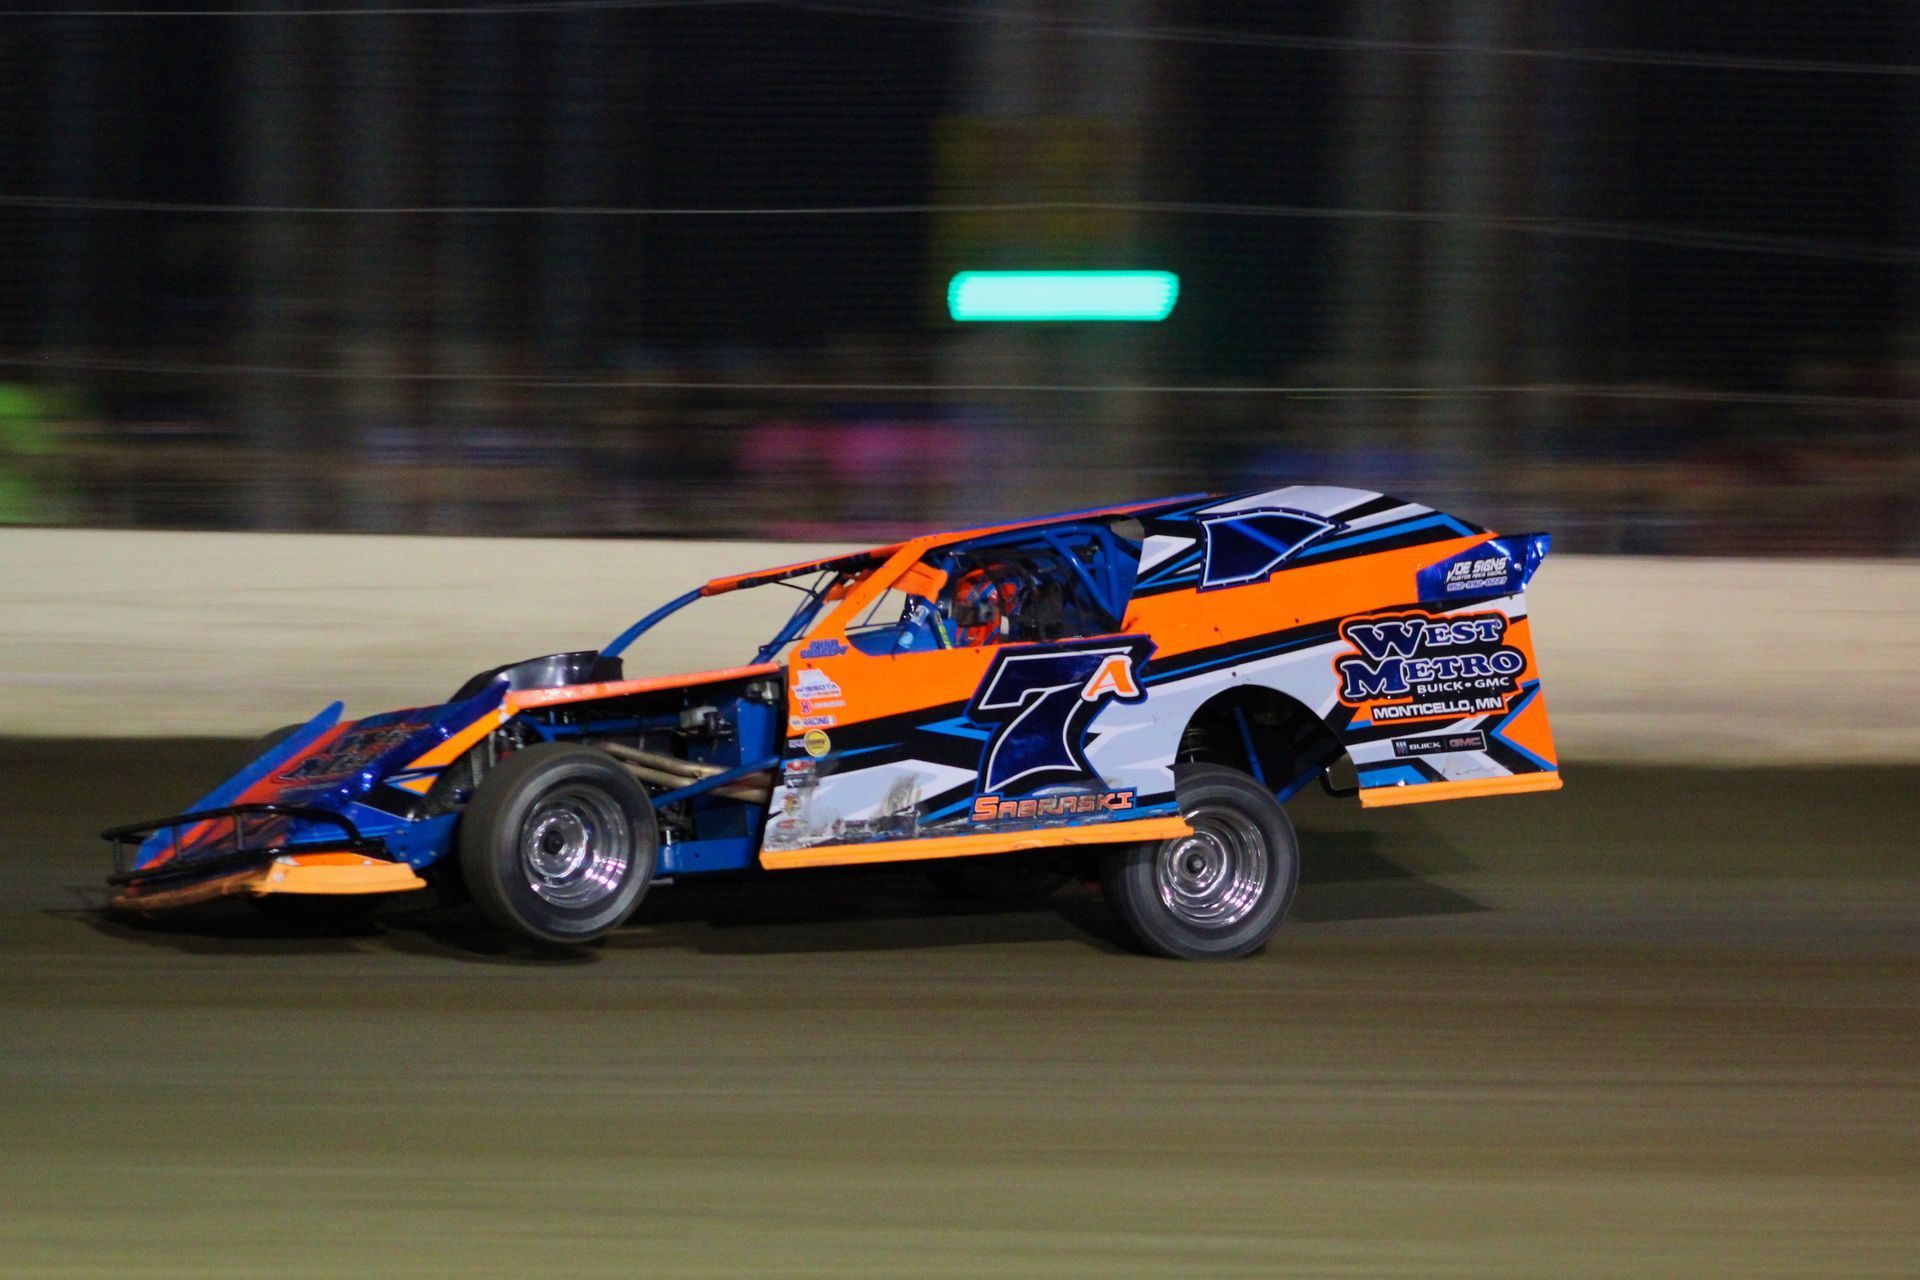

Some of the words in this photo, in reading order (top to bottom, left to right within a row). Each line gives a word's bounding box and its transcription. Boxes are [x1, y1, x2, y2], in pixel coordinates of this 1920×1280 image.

[1445, 561, 1472, 583] JOE
[1472, 557, 1507, 574] SIGNS
[1347, 619, 1502, 660] WEST
[1340, 650, 1522, 697] METRO
[1417, 680, 1463, 695] BUICK
[1474, 676, 1510, 689] GMC
[1373, 699, 1475, 720] MONTICELLO,
[1476, 696, 1503, 711] MN
[1408, 741, 1442, 751] BUICK
[1449, 736, 1482, 748] GMC
[972, 791, 1134, 822] SABRASKI
